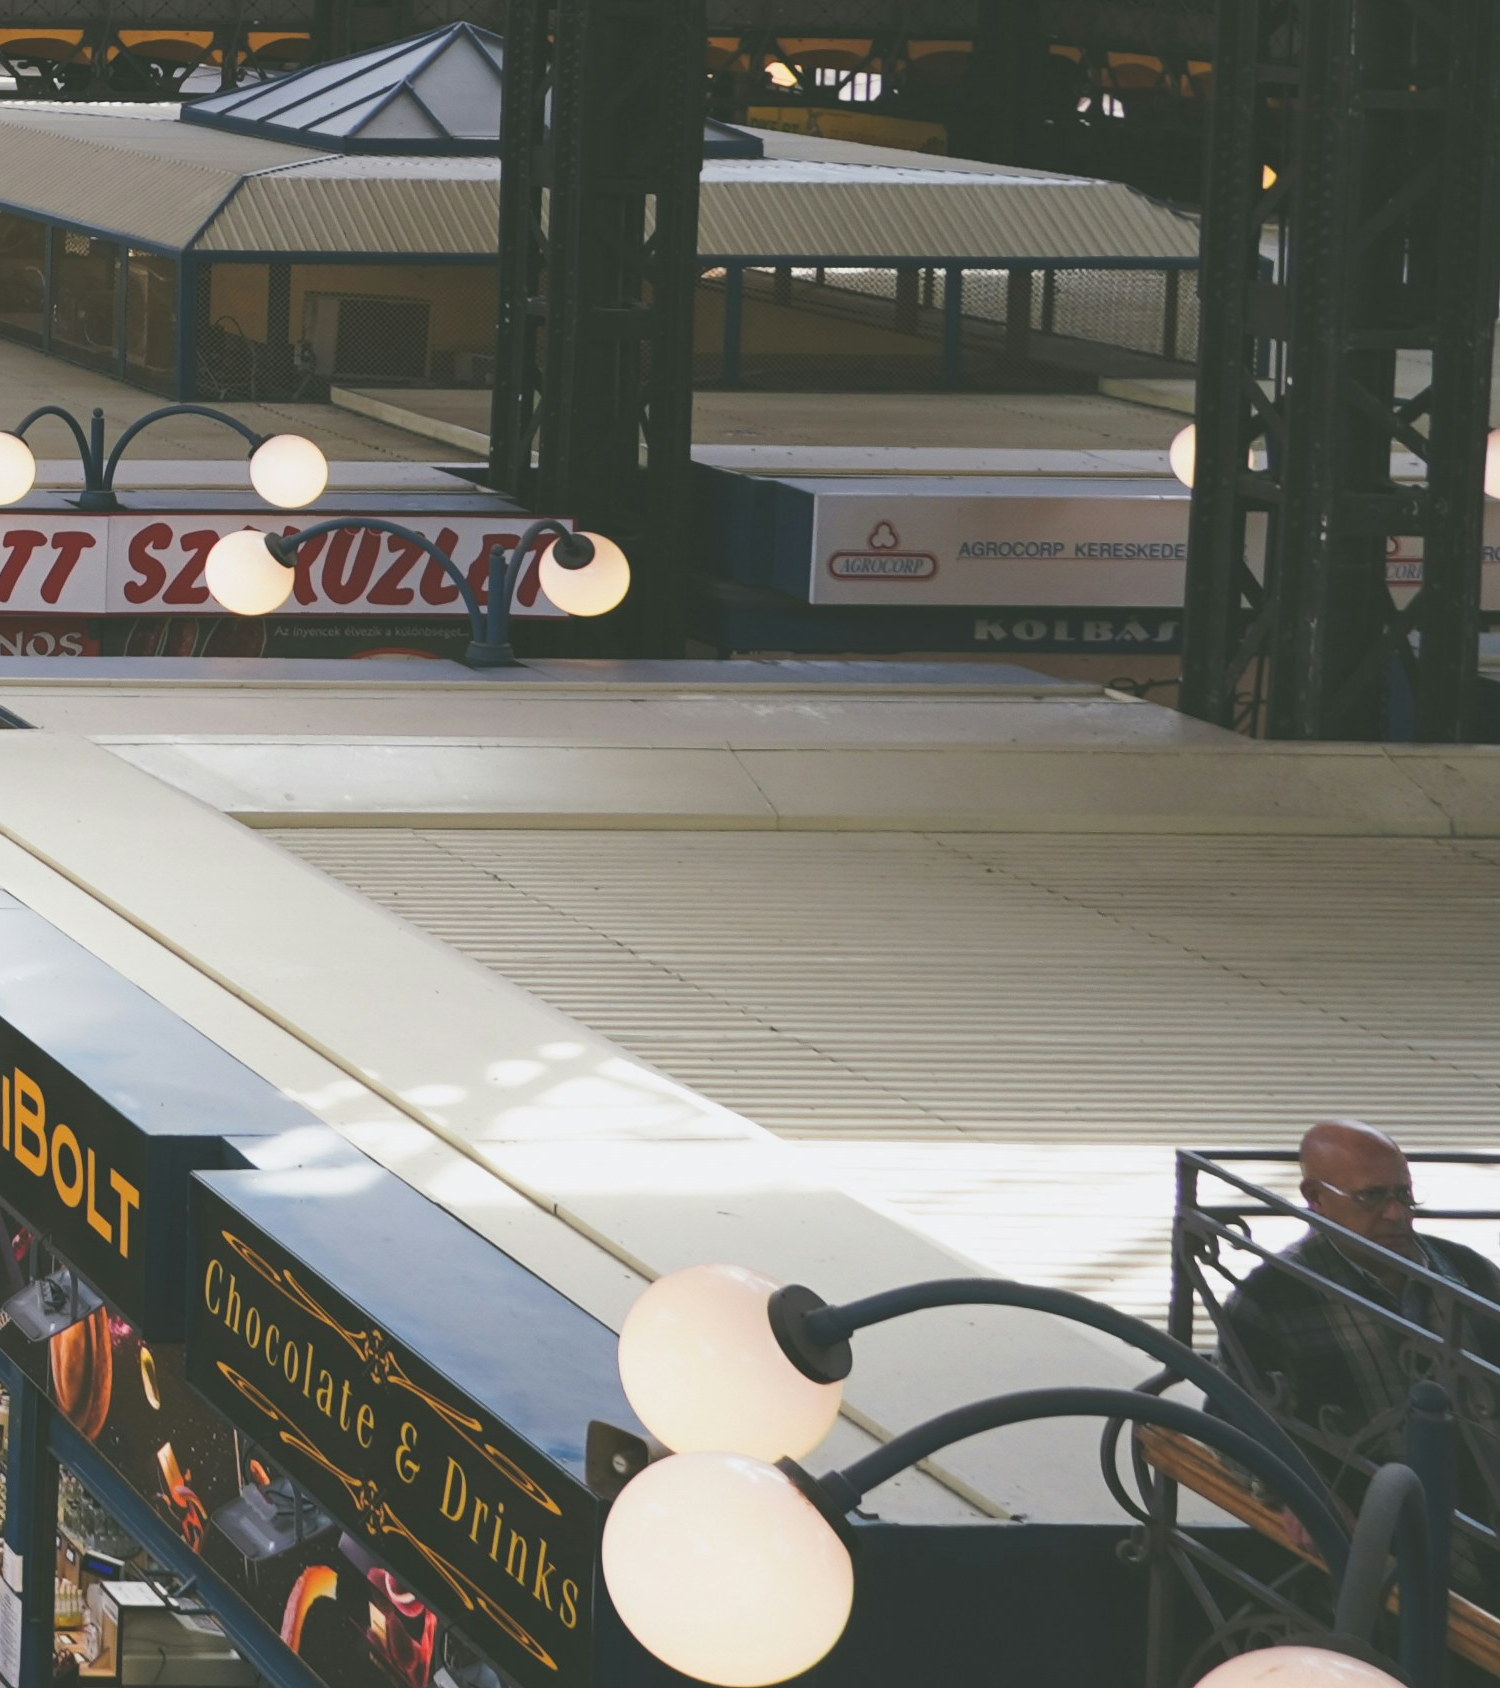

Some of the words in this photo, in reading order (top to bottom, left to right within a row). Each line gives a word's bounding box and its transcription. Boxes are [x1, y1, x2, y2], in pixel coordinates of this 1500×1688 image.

[959, 541, 1064, 558] AGROCORP
[1075, 541, 1187, 558] KERESKEDE
[124, 521, 564, 607] SZKÜZLET
[840, 557, 924, 574] AGROCORP
[274, 625, 289, 637] Az
[293, 624, 341, 639] ínyencek
[344, 624, 382, 637] élvezik
[385, 628, 393, 637] a
[205, 1258, 375, 1449] Chocolate
[395, 1421, 421, 1485] &
[439, 1455, 580, 1629] Drinks
